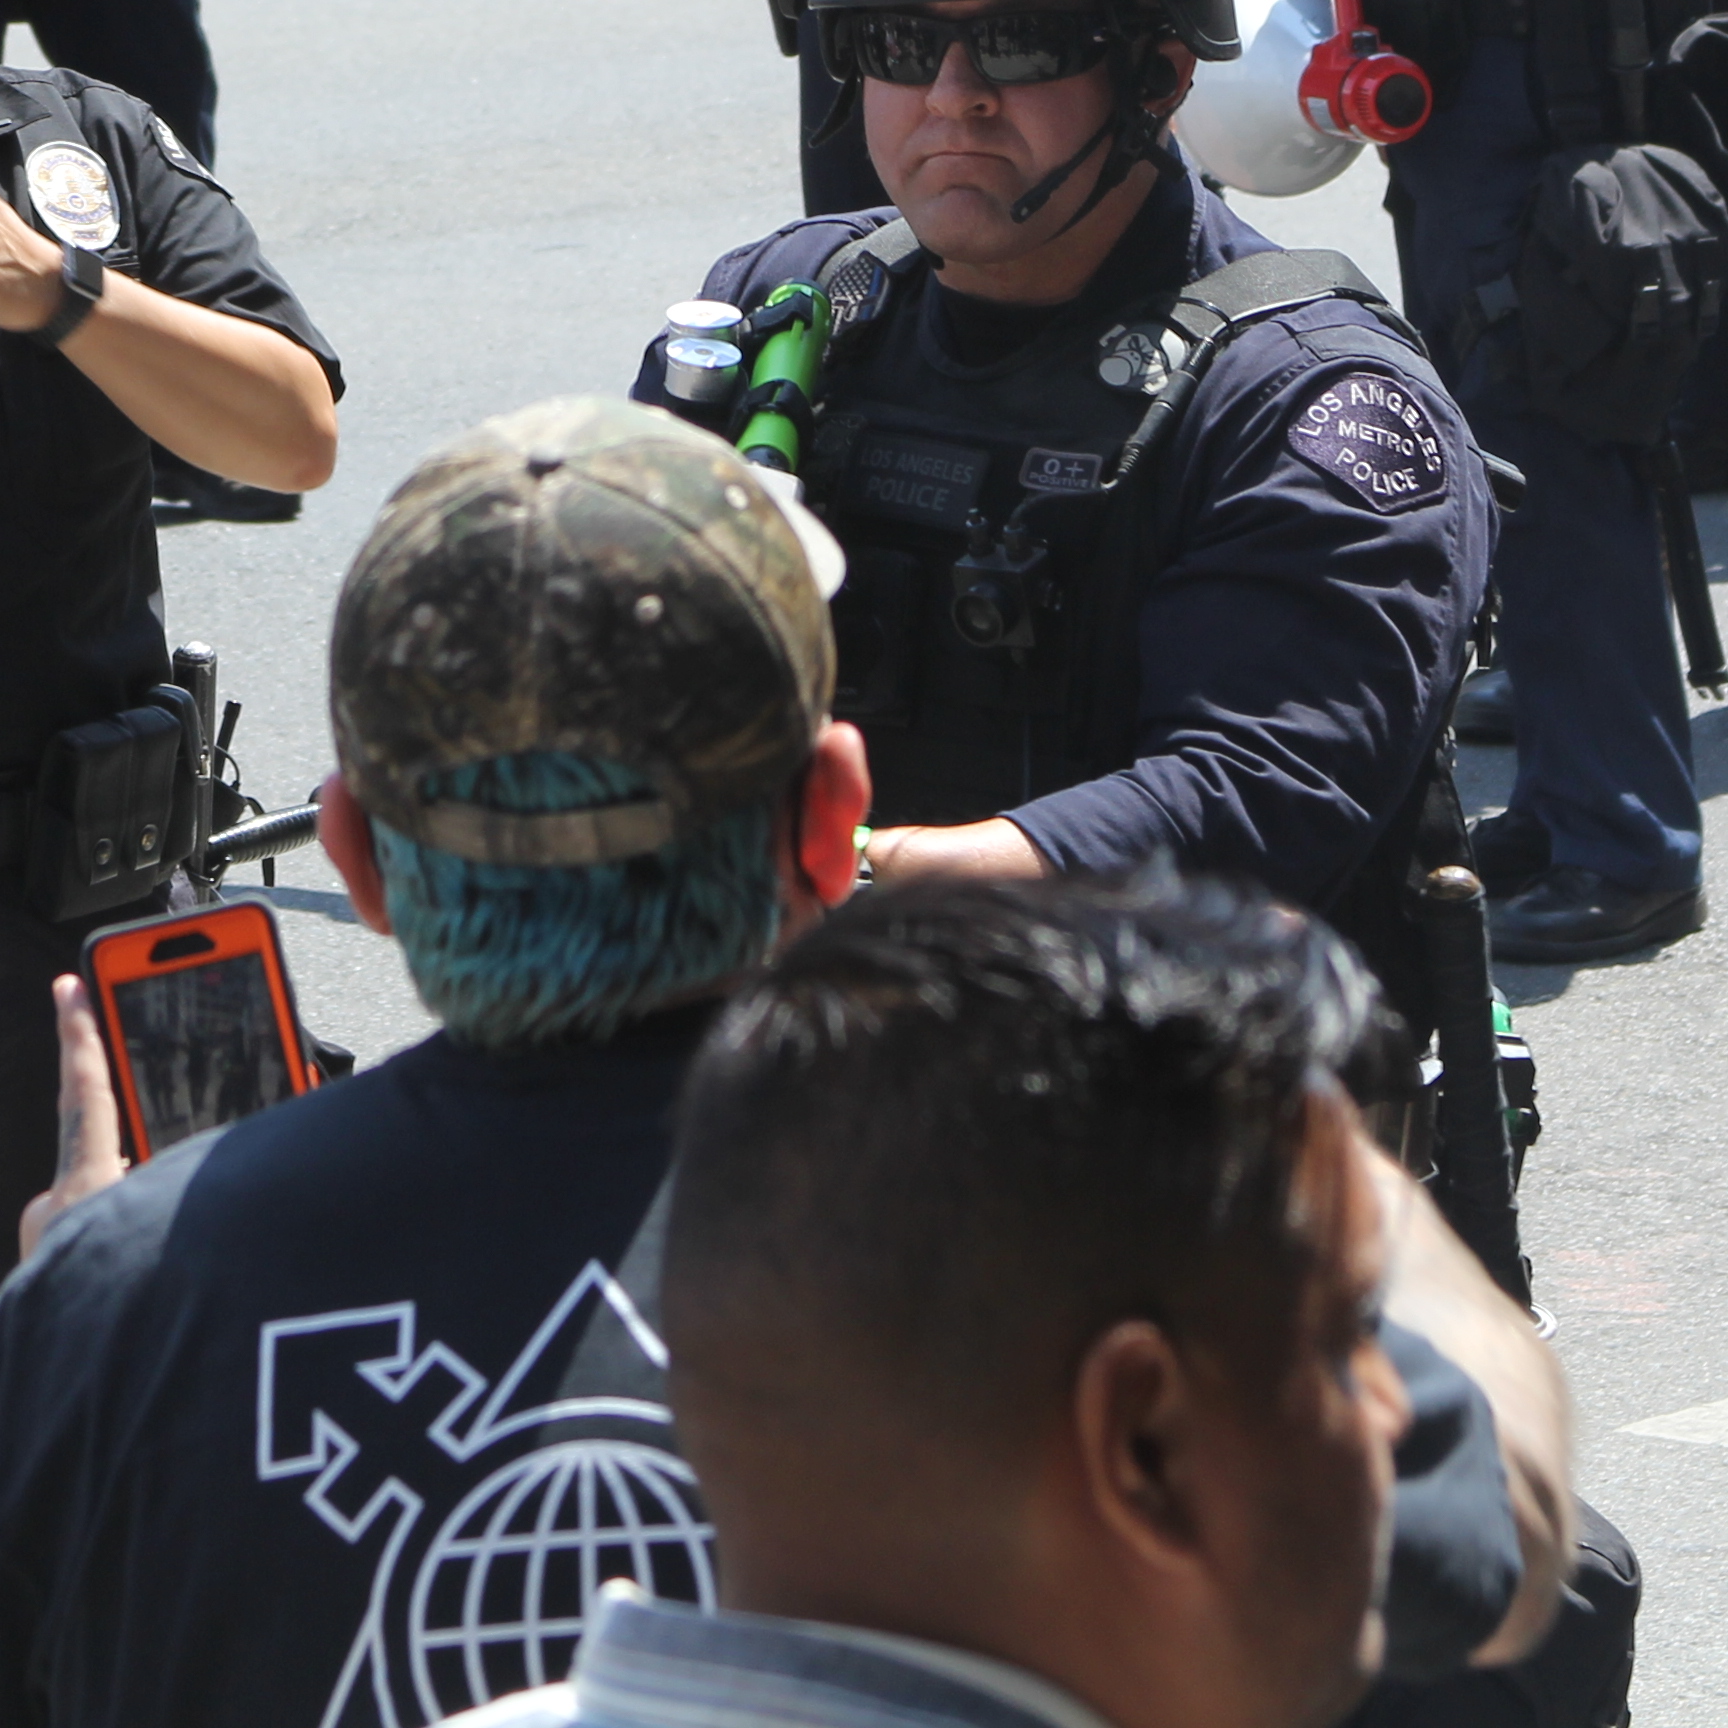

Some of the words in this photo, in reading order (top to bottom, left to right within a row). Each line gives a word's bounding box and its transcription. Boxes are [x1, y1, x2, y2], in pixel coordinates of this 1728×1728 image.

[1297, 392, 1343, 439] LOS
[1350, 383, 1443, 473] ANGELES
[1338, 419, 1415, 457] METRO
[860, 446, 894, 468] LOS
[896, 450, 974, 486] ANGELES
[1334, 446, 1421, 497] POLICE
[864, 475, 952, 512] POLICE
